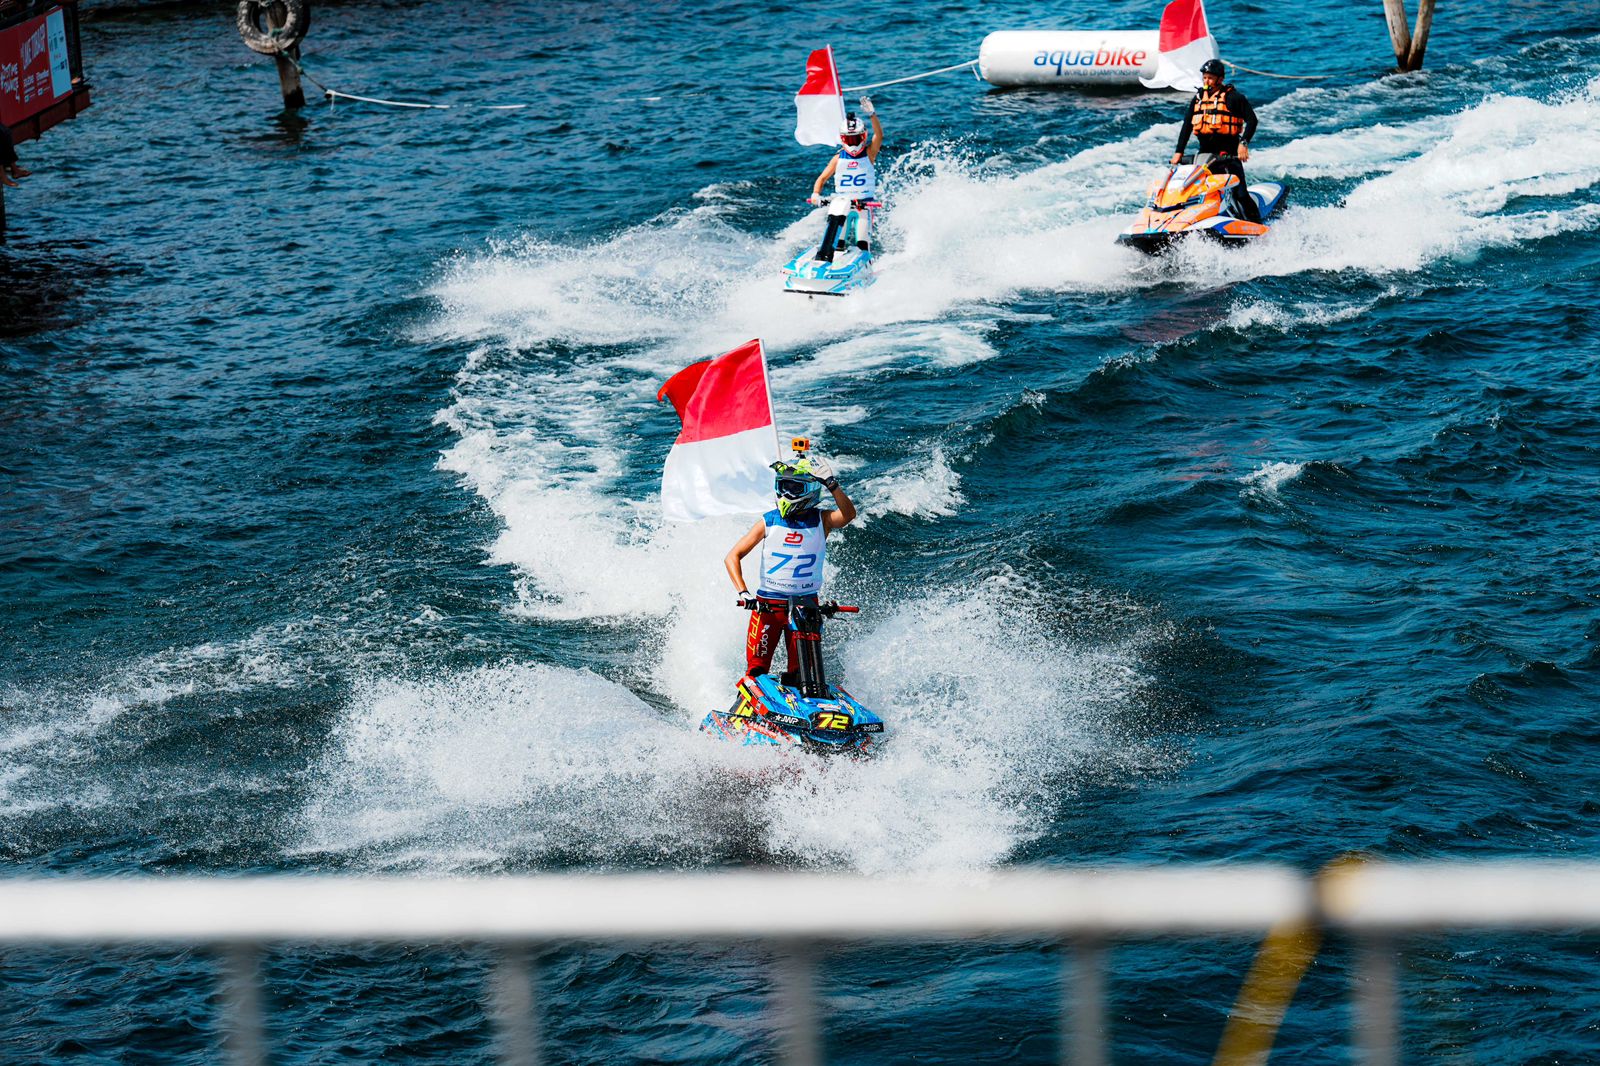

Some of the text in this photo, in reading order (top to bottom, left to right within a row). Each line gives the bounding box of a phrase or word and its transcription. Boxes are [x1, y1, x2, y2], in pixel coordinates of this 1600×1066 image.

[1033, 48, 1146, 76] aquabike
[840, 173, 867, 187] 26
[766, 552, 817, 578] 72
[818, 713, 849, 730] 72
